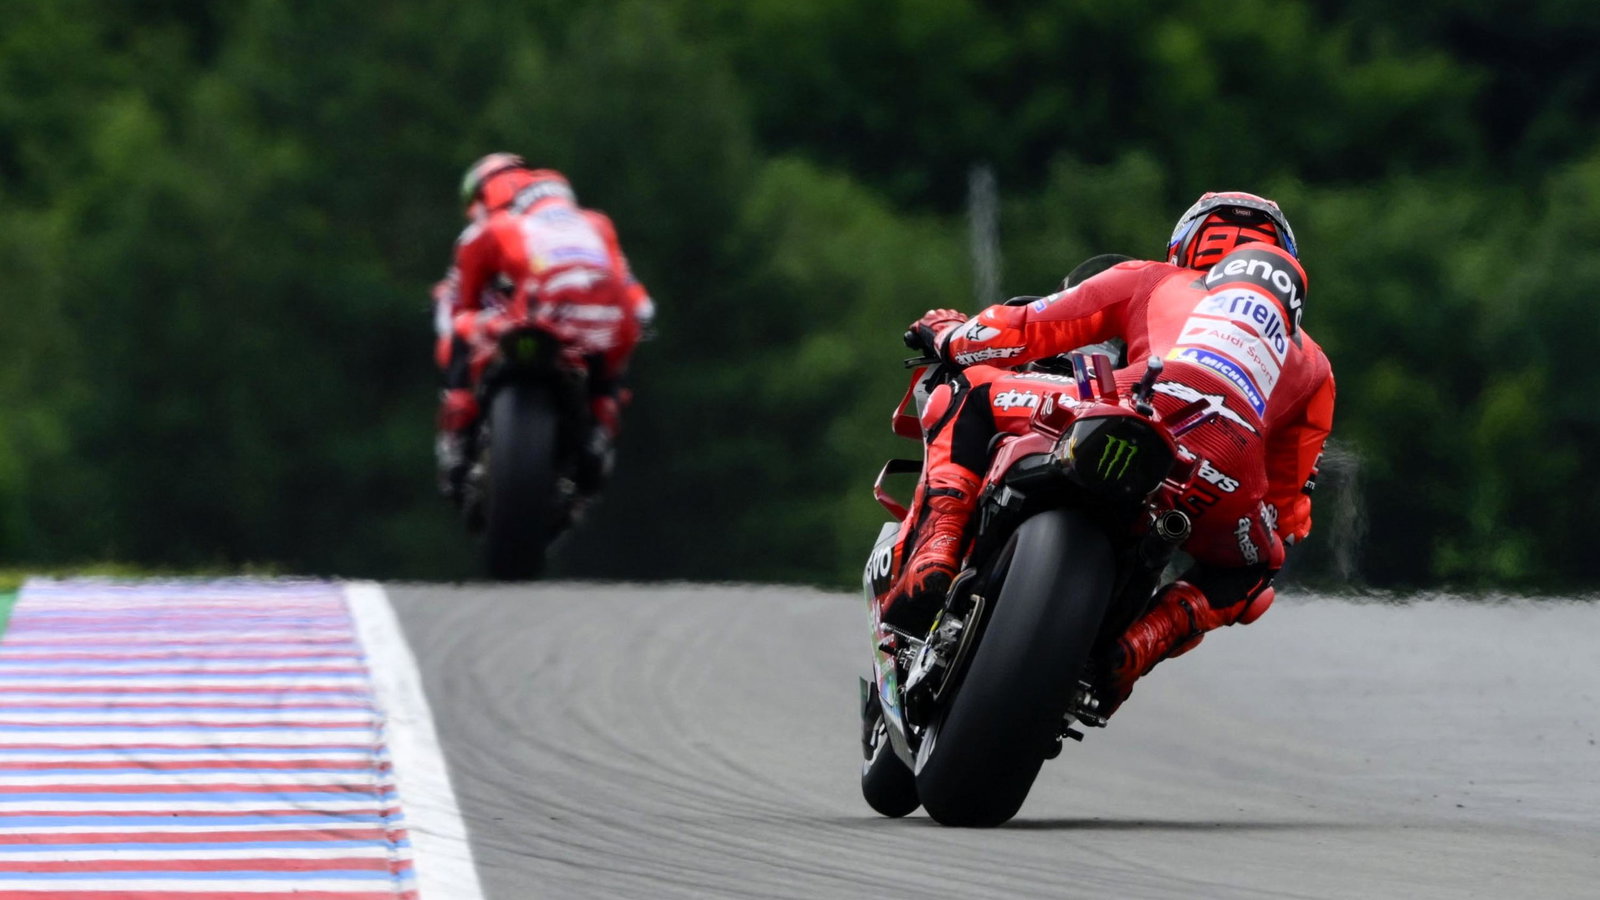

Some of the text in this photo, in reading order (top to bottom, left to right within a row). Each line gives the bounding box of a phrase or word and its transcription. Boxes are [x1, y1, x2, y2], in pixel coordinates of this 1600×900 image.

[1229, 295, 1285, 354] riello
[1200, 356, 1260, 407] MICHELIN
[1208, 329, 1274, 385] Audi Sport
